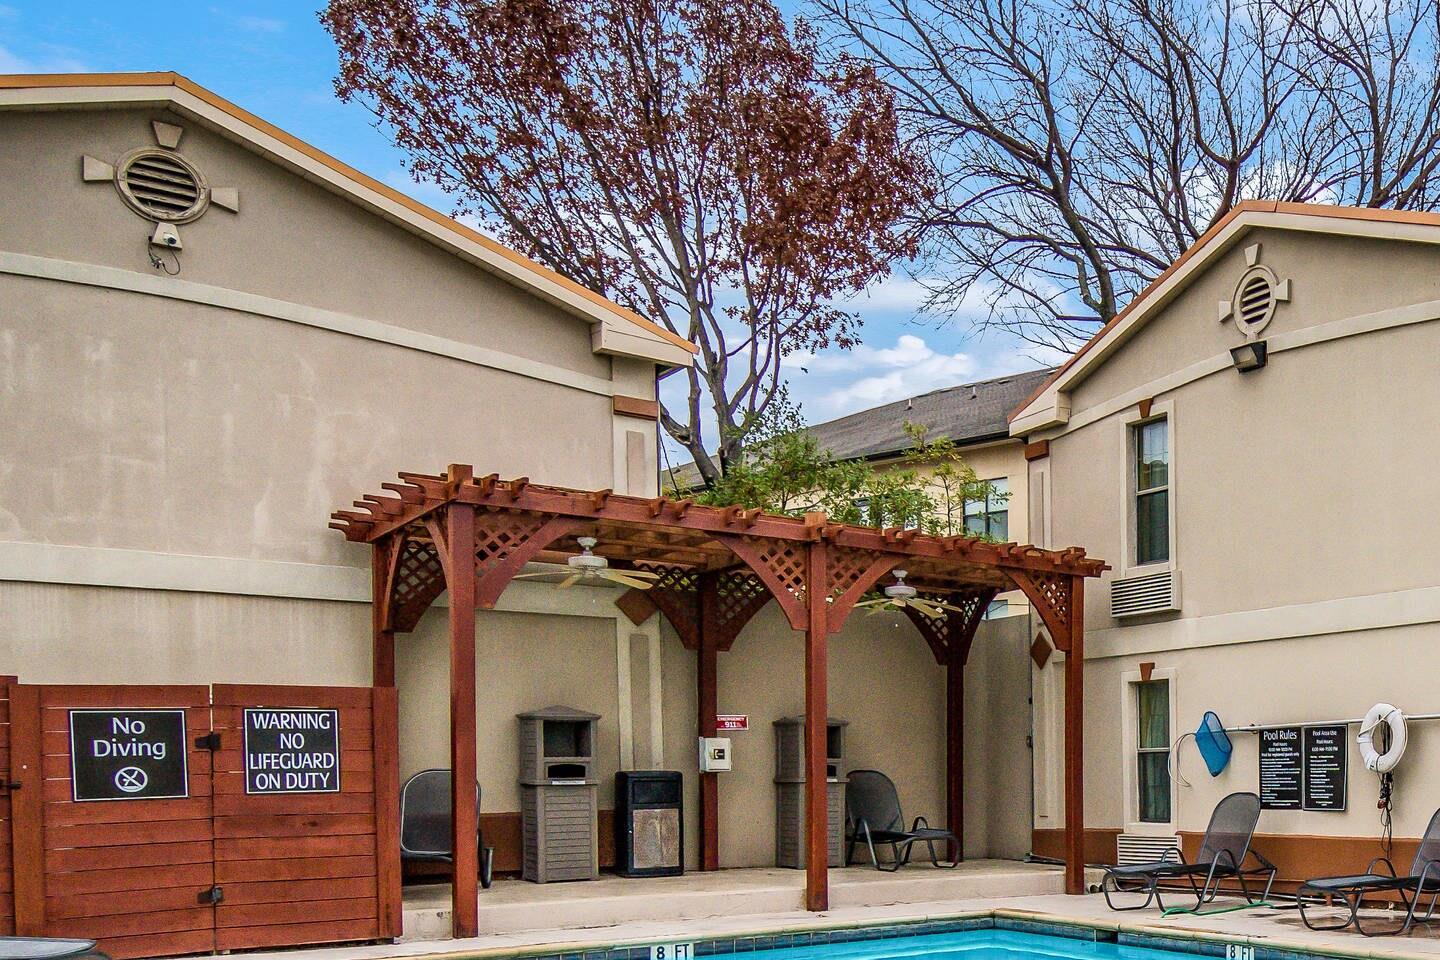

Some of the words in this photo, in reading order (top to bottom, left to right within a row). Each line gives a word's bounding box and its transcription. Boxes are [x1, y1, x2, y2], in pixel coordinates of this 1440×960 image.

[112, 717, 146, 735] No
[252, 713, 330, 730] WARNING
[280, 733, 305, 750] NO
[1263, 730, 1279, 741] Pool
[1279, 729, 1298, 740] Rules
[93, 737, 167, 760] Diving
[249, 752, 335, 770] LIFEGUARD
[255, 773, 281, 790] ON
[286, 772, 330, 789] DUTY
[656, 946, 665, 960] 8
[1230, 945, 1236, 959] 8
